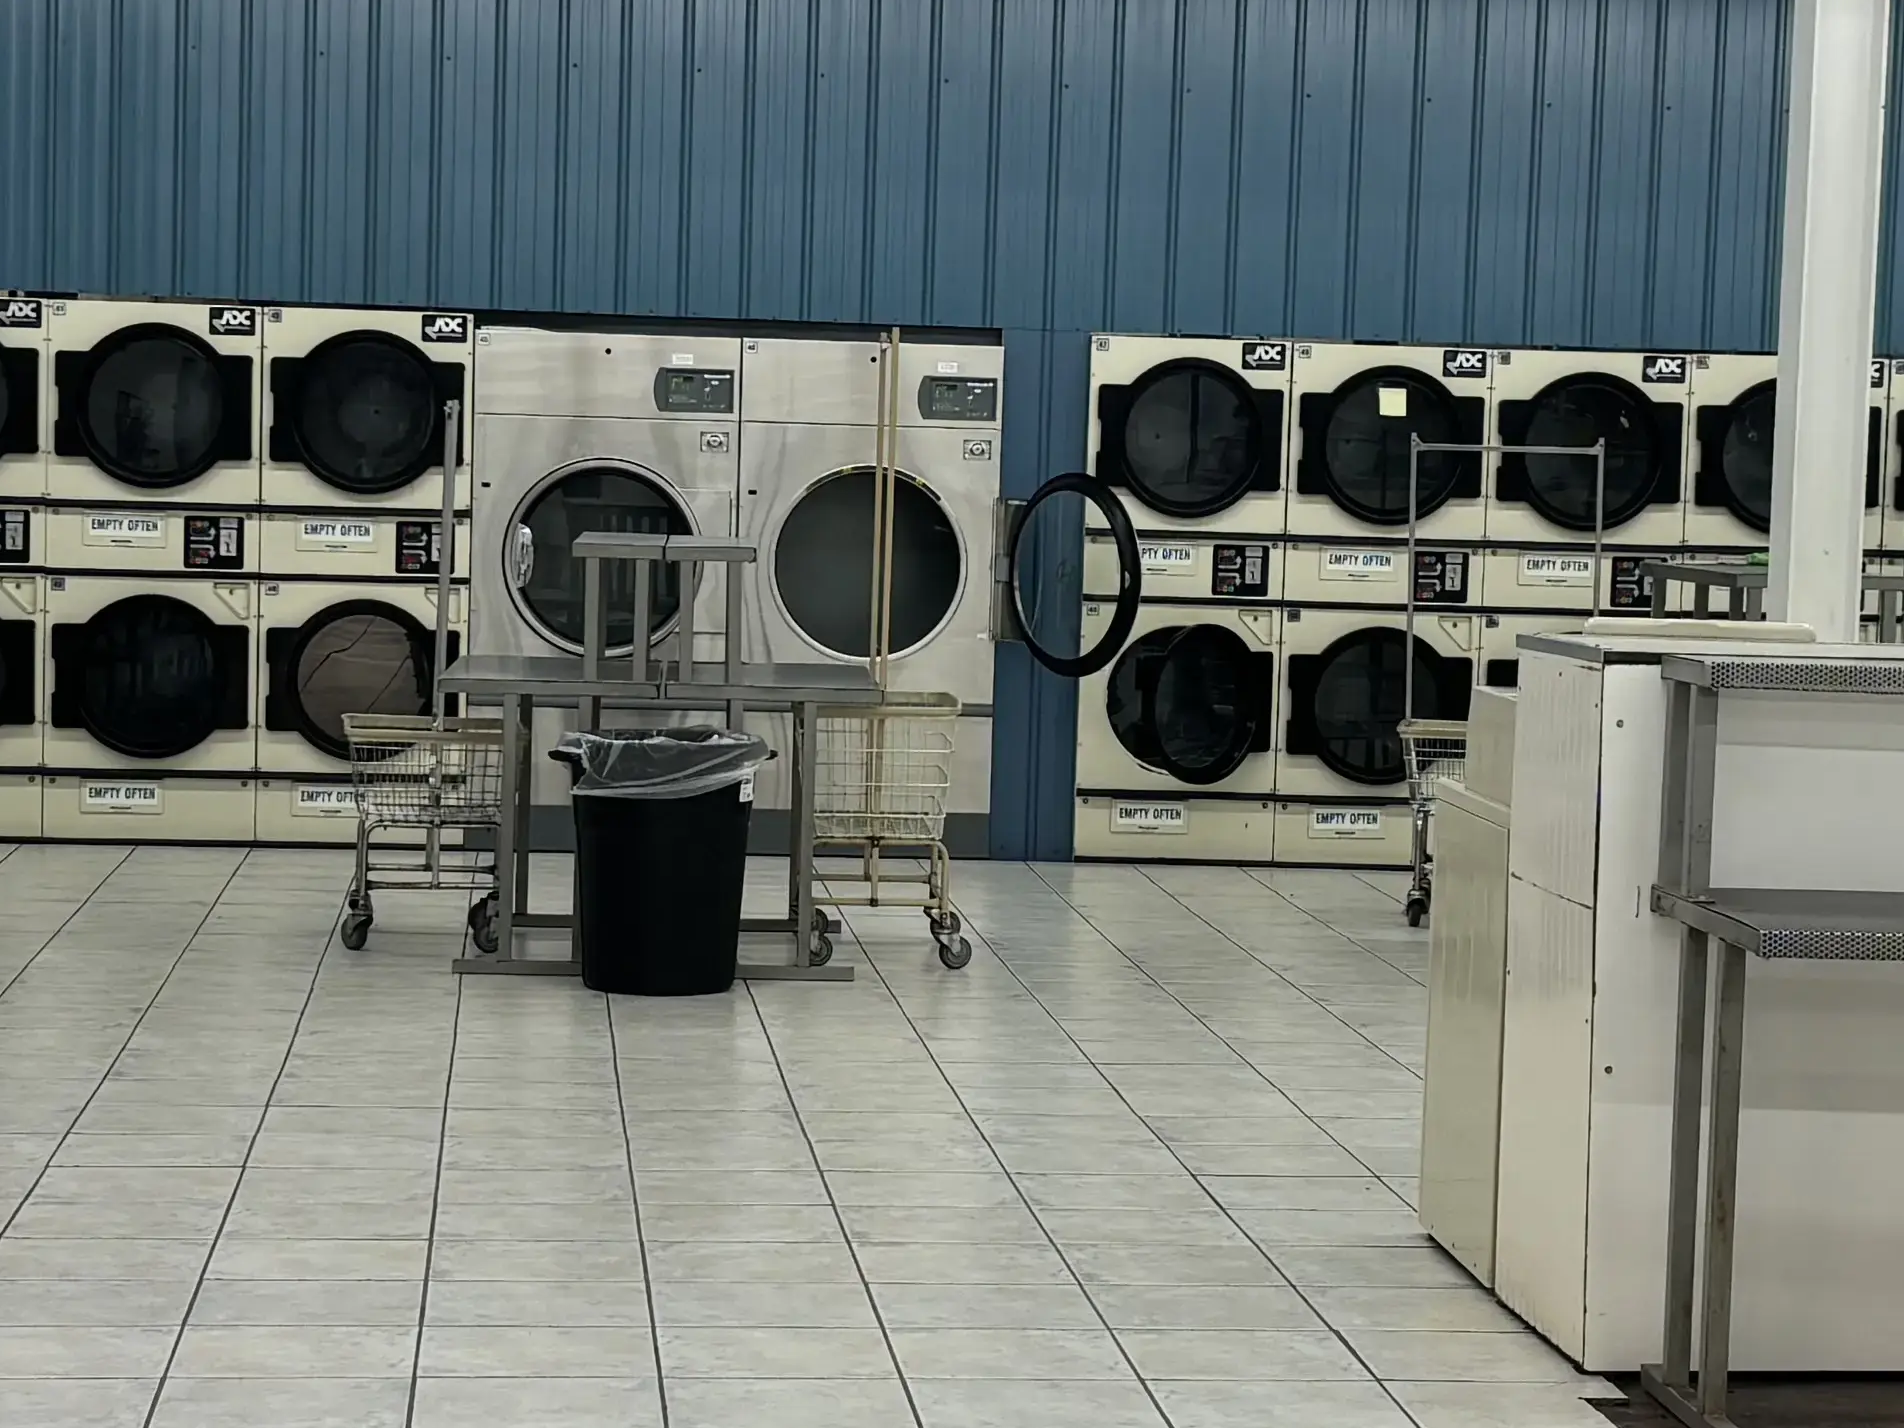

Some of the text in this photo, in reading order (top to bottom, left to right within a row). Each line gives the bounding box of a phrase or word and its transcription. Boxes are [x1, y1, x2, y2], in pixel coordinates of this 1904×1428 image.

[6, 302, 37, 317] ADC
[221, 310, 251, 325] ADC
[433, 317, 462, 332] ADC
[1254, 345, 1282, 360] ADC
[1454, 353, 1483, 367] ADC
[1655, 358, 1682, 373] ADC
[92, 518, 159, 531] EMPTY OFTEN
[304, 524, 371, 536] EMPTY OFTEN
[1162, 548, 1190, 560] OFTEN
[1329, 554, 1392, 566] EMPTY OFTEN
[1527, 559, 1589, 571] EMPTY OFTEN
[89, 787, 156, 799] EMPTY OFTEN
[301, 790, 333, 802] EMPTY
[1120, 808, 1182, 820] EMPTY OFTEN
[1316, 813, 1378, 824] EMPTY OFTEN
